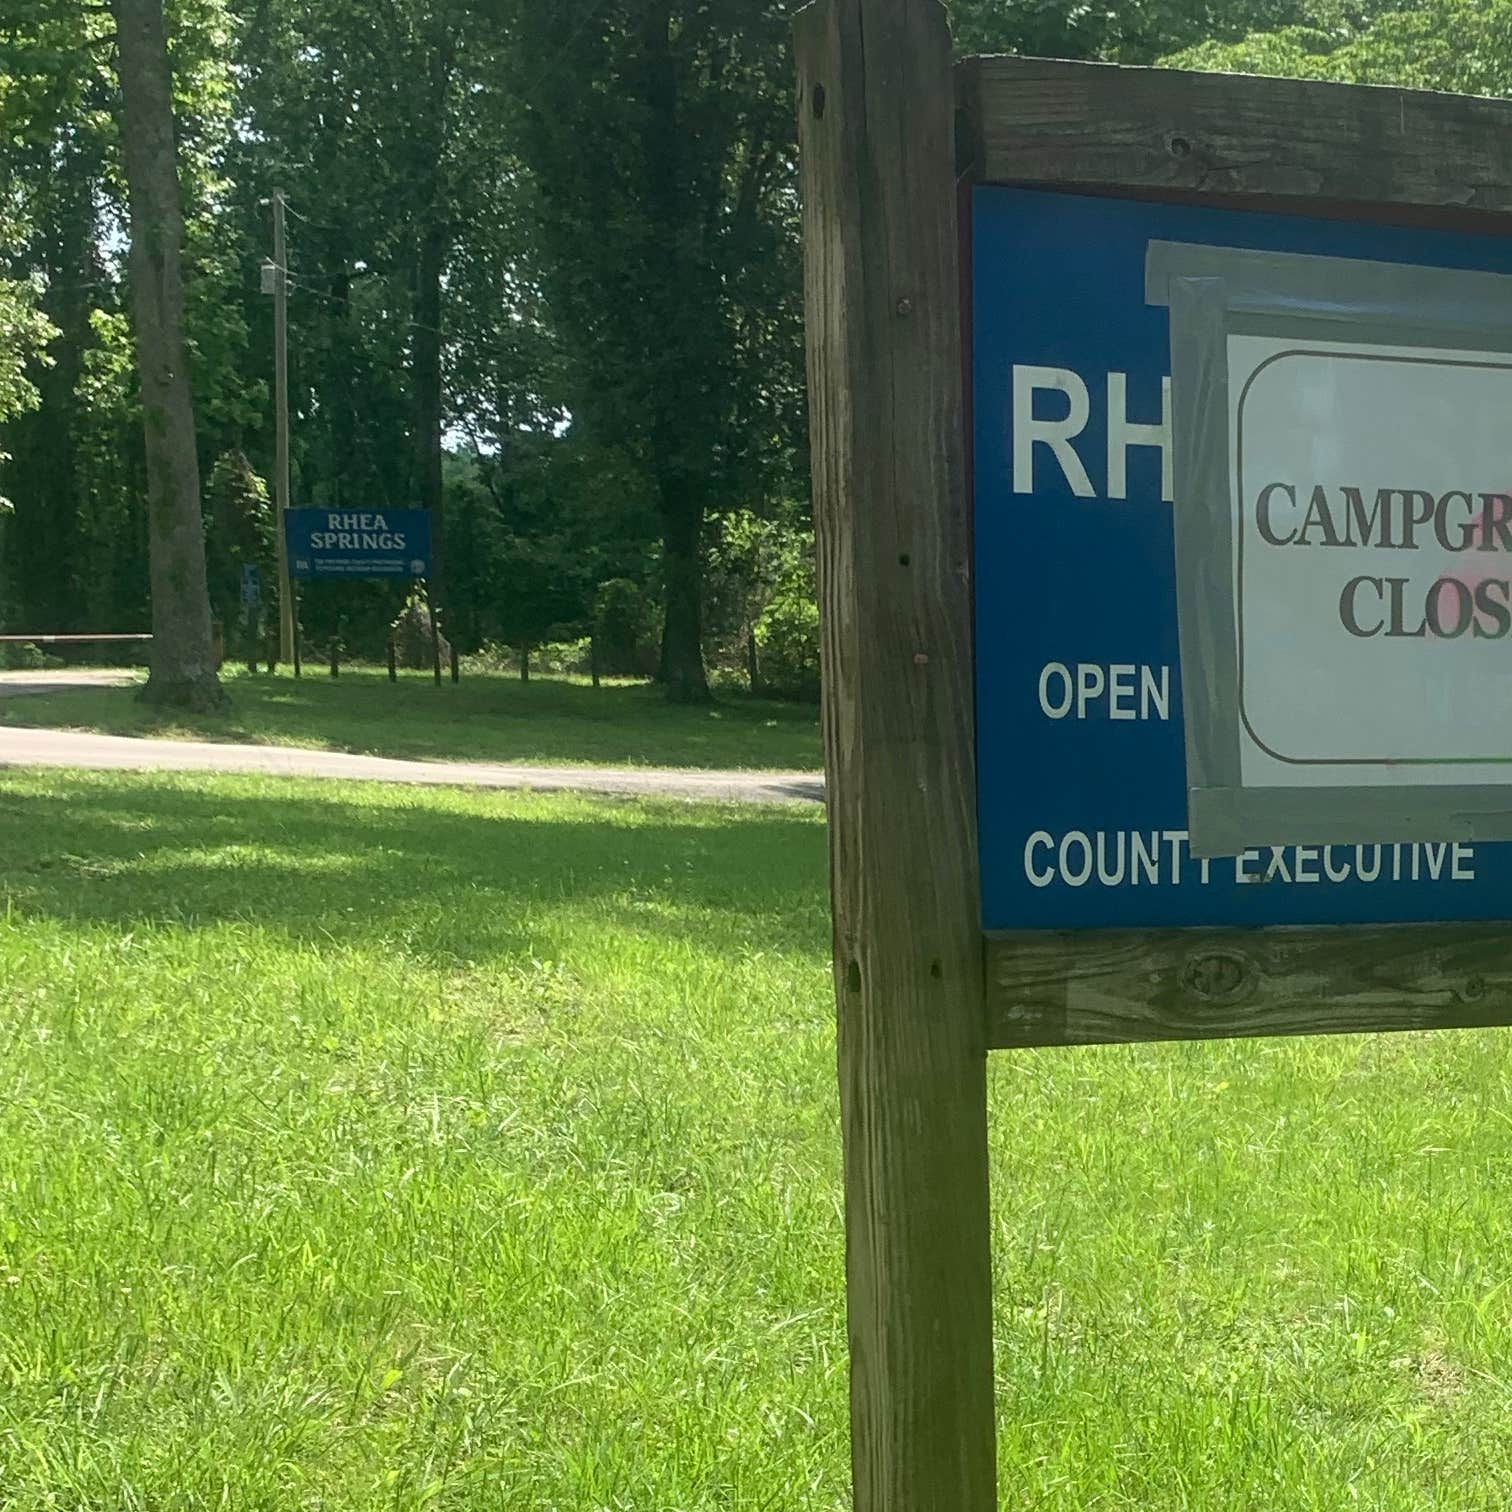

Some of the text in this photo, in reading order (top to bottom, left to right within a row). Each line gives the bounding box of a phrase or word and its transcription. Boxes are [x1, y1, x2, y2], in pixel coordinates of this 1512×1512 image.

[1012, 364, 1174, 503] RH
[310, 532, 406, 549] SPRINGS
[328, 513, 388, 530] RHEA
[1038, 661, 1170, 721] OPEN
